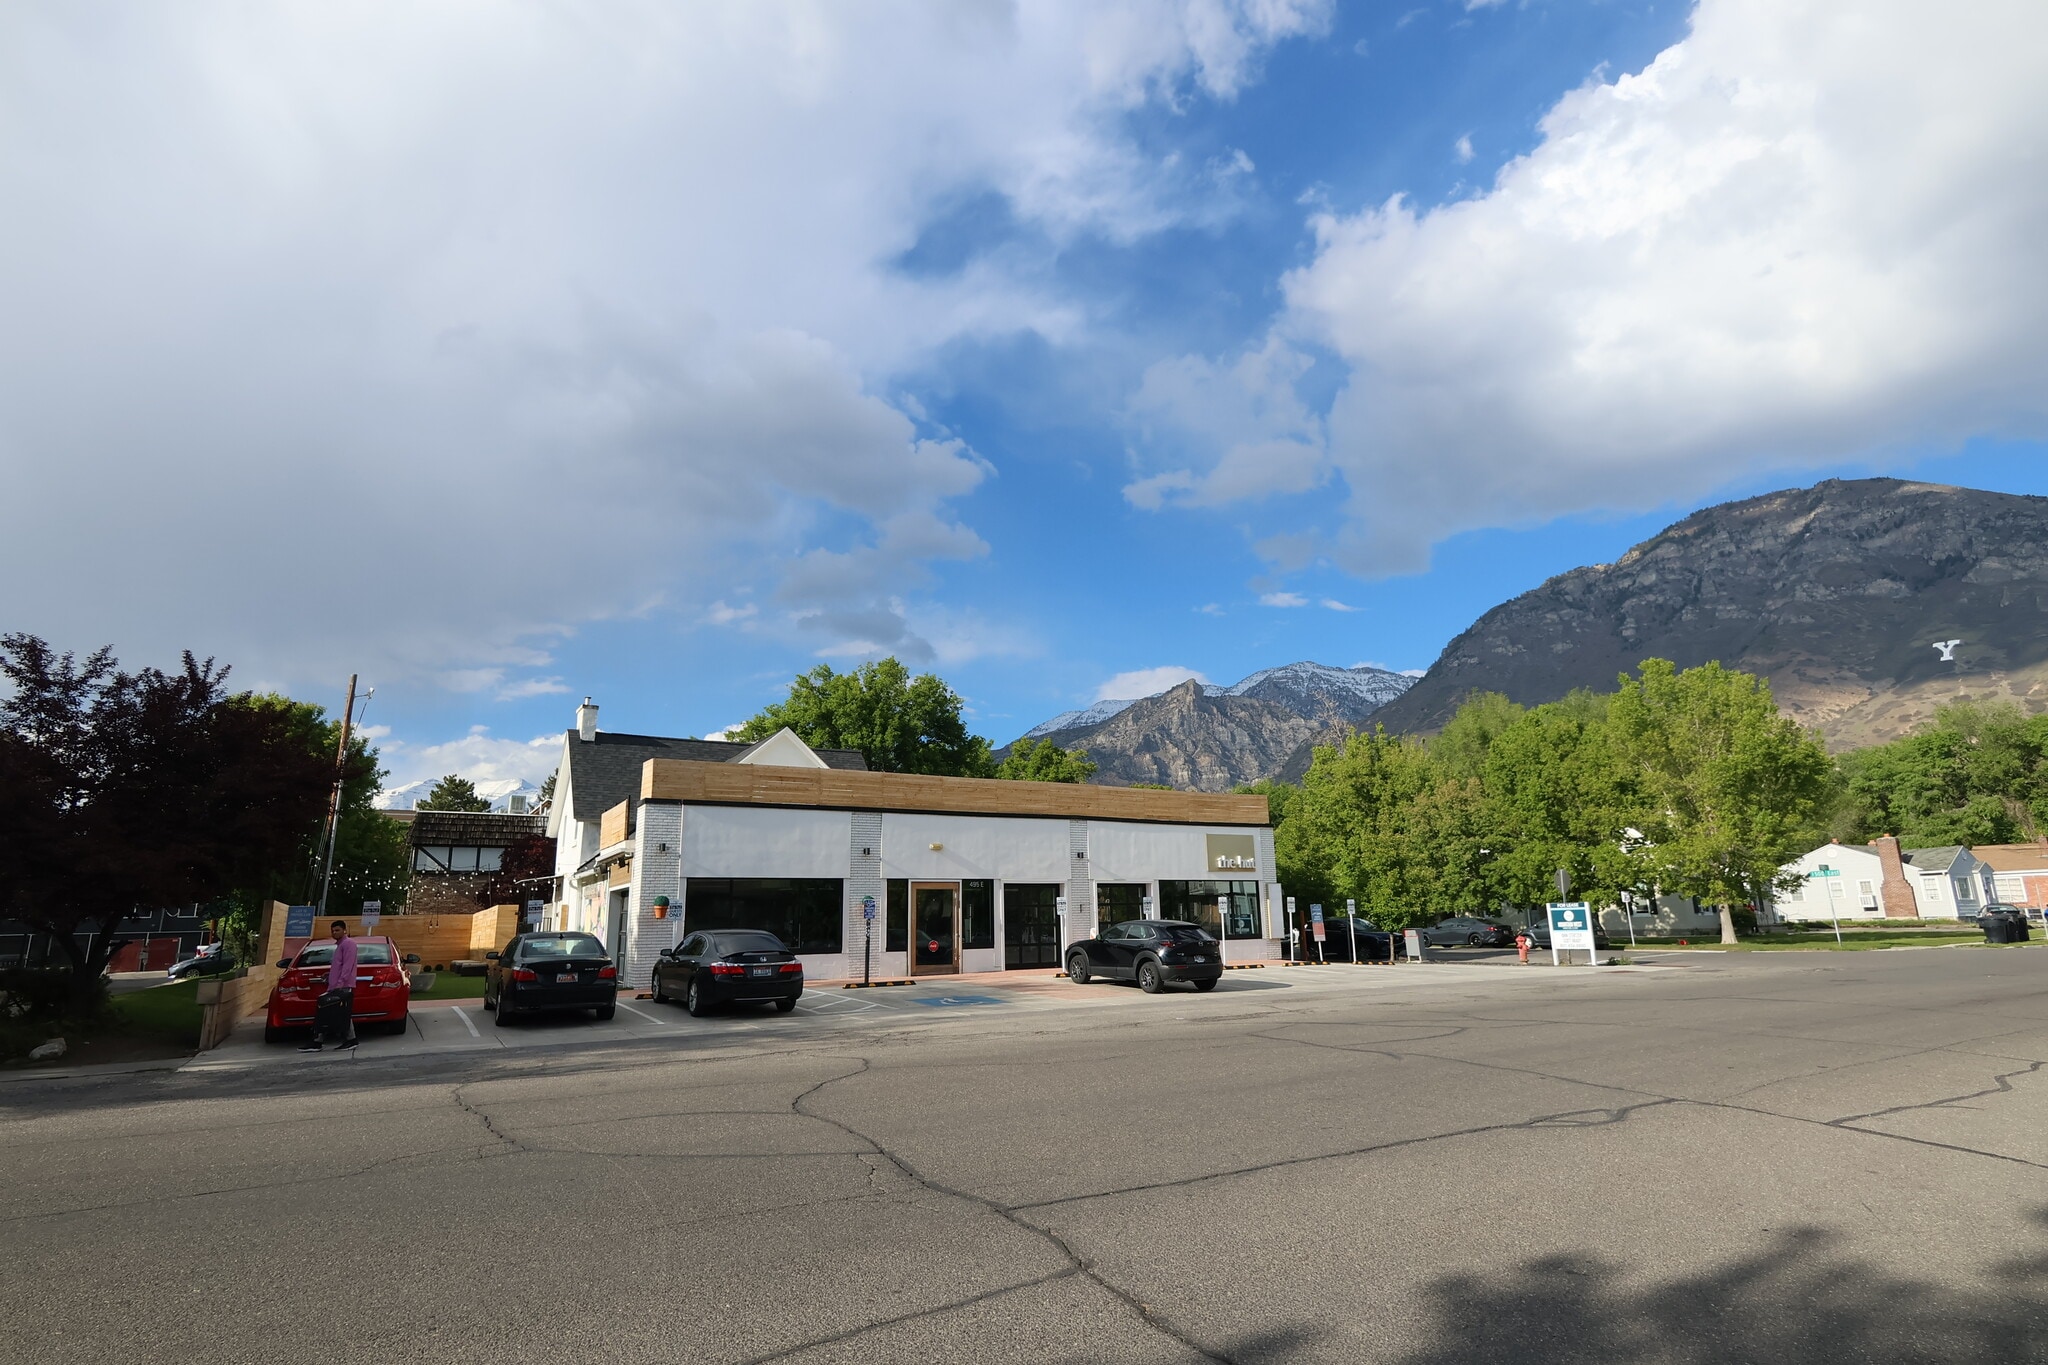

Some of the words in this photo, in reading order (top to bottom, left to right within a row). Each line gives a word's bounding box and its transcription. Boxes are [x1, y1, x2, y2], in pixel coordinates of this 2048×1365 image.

[1932, 639, 1961, 662] Y
[1216, 855, 1236, 868] the
[1237, 855, 1256, 868] hut
